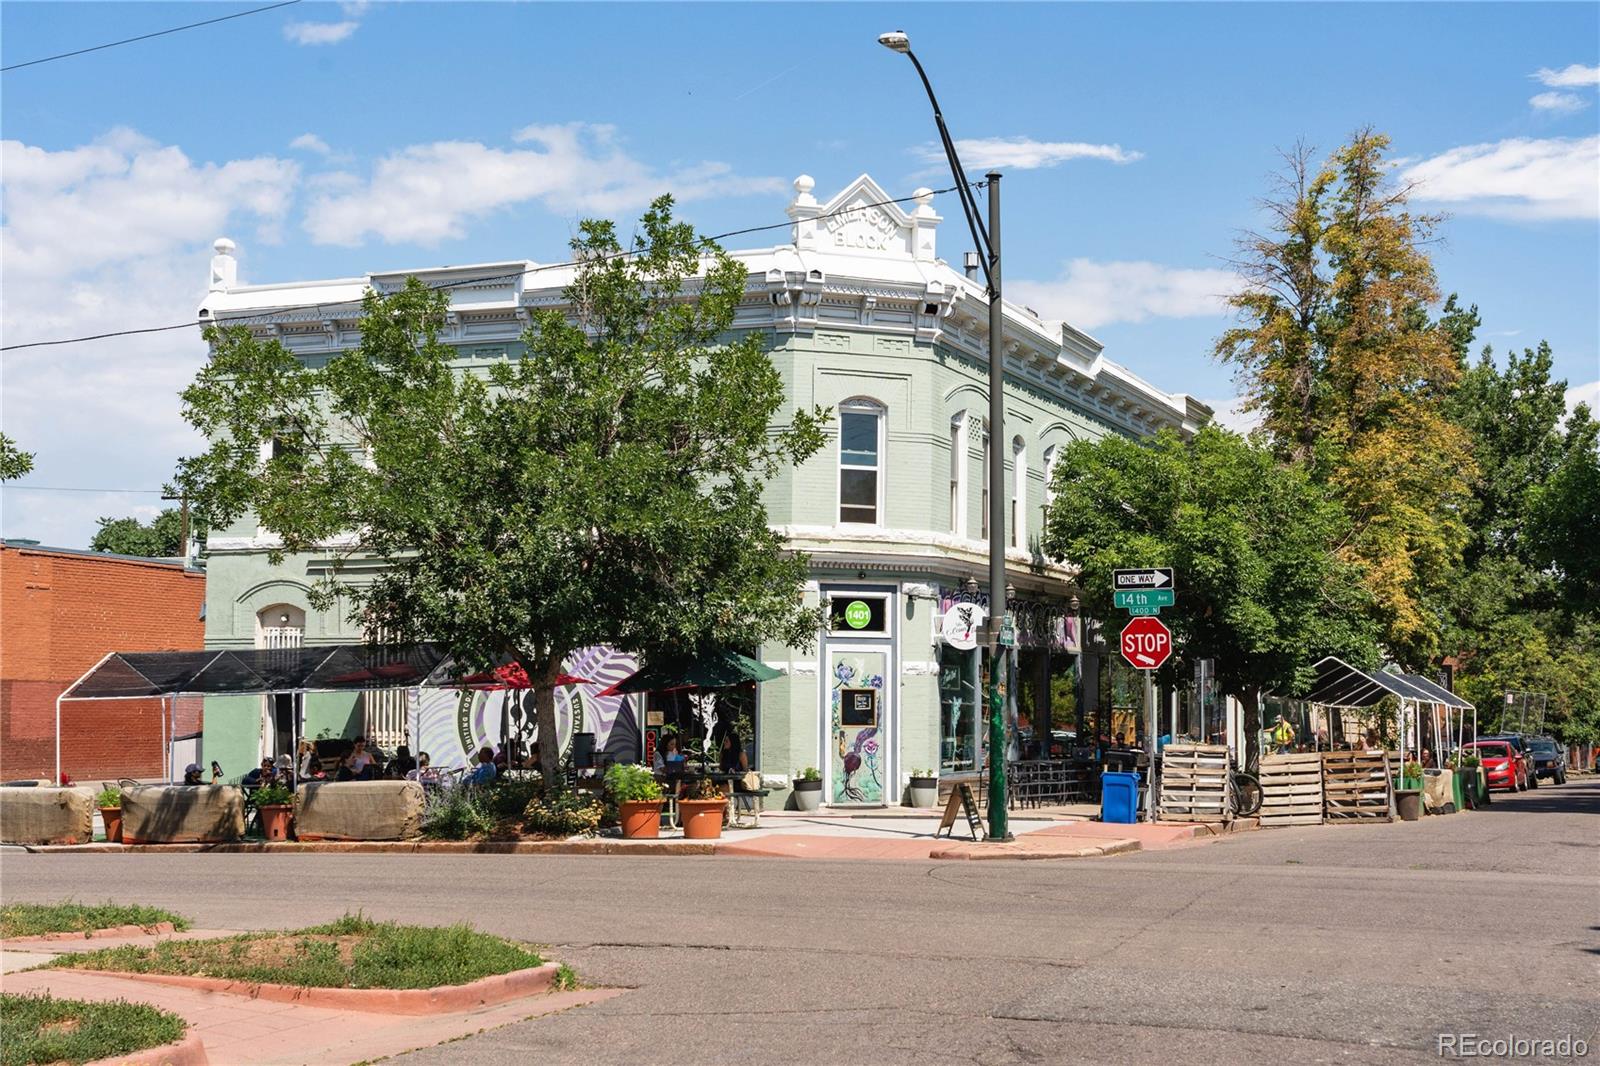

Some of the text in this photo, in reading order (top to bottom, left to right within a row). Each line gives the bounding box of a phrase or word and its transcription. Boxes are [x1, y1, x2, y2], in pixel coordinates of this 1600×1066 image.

[825, 203, 897, 240] EMERSON
[834, 230, 888, 251] BLOCK
[1120, 574, 1155, 584] ONE WAY
[1121, 593, 1148, 605] 14th
[847, 610, 869, 620] 1401
[1125, 633, 1167, 653] STOP
[462, 716, 475, 750] UNITING
